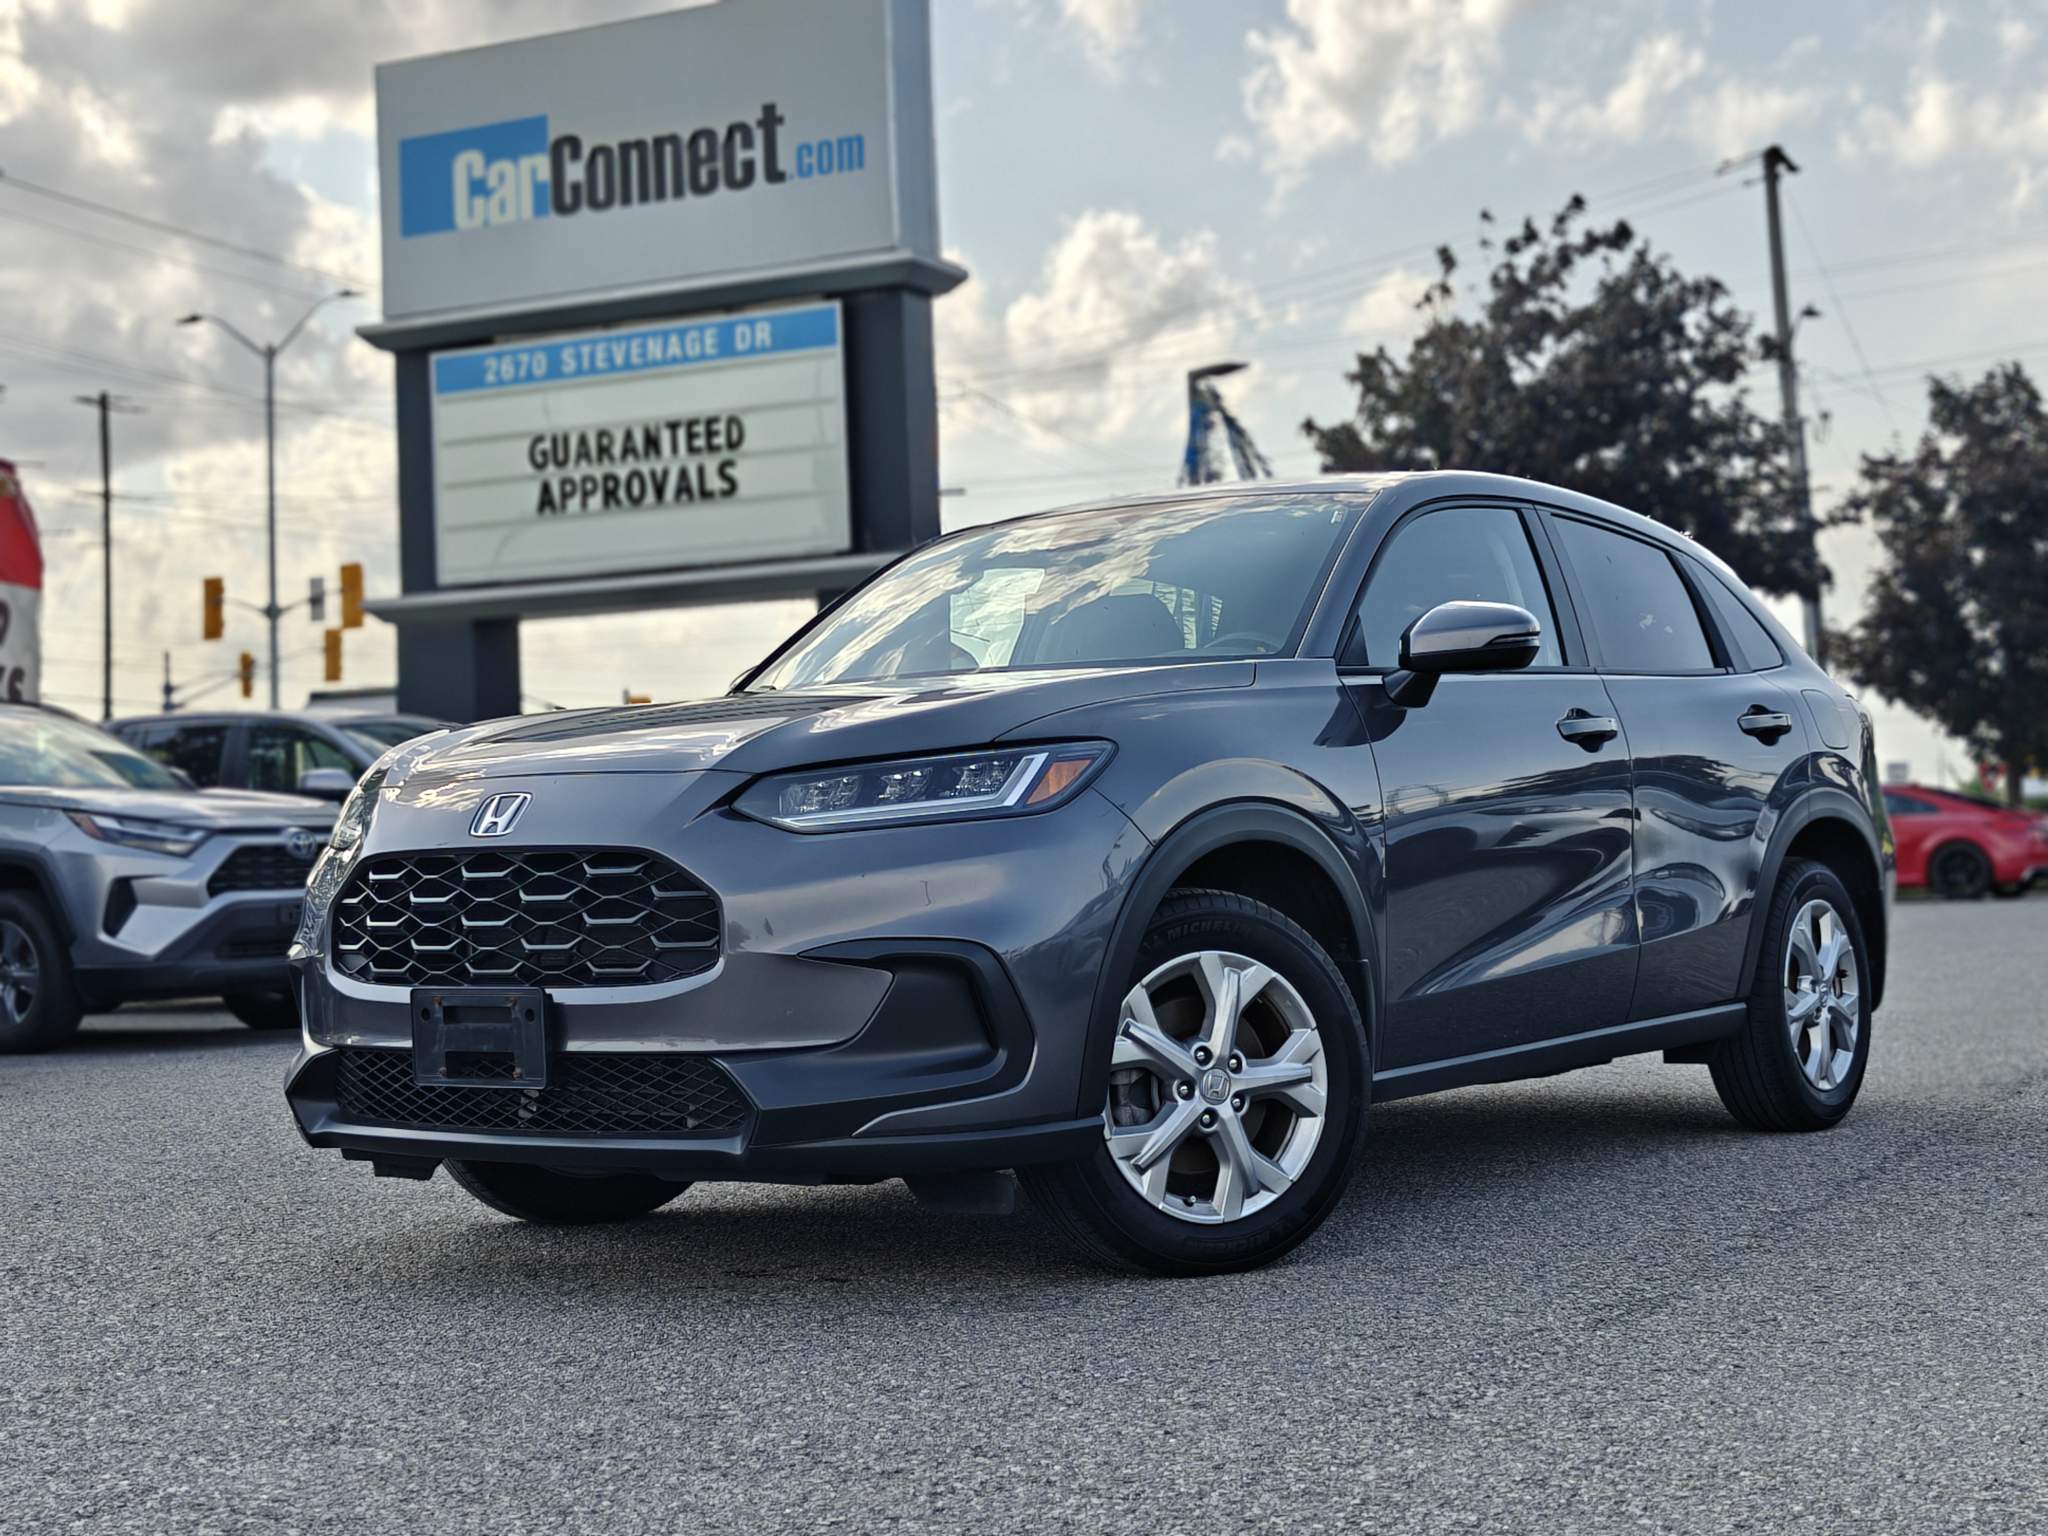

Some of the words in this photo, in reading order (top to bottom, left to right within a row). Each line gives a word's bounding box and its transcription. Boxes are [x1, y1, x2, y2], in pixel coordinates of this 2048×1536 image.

[453, 102, 865, 231] CarConnect.com
[484, 351, 548, 384] 2670
[561, 327, 720, 374] STEVENAGE
[735, 320, 773, 351] DR
[528, 414, 746, 472] GUARANTEED
[537, 459, 739, 516] APPROVALS
